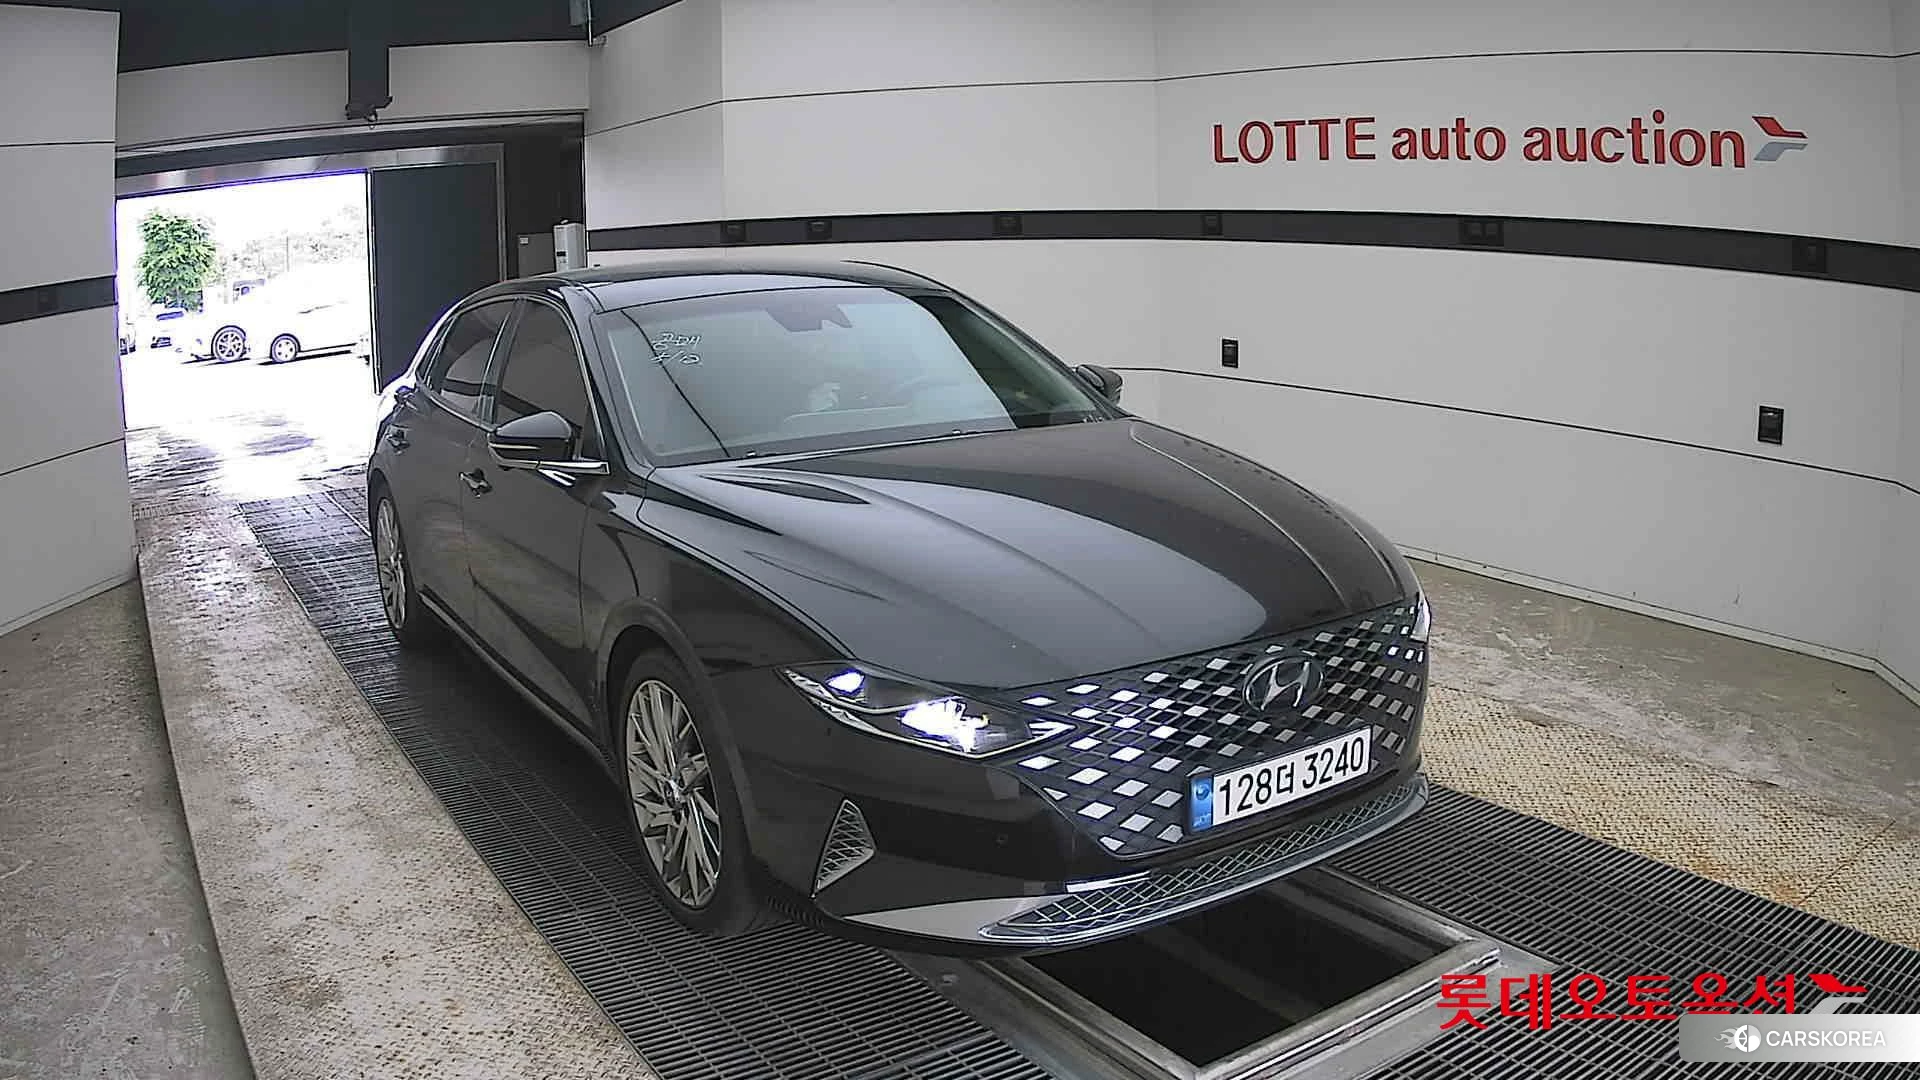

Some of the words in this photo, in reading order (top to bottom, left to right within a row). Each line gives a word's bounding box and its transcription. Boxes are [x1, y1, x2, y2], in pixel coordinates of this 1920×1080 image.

[1213, 116, 1376, 163] LOTTE
[1391, 117, 1507, 162] auto
[1522, 109, 1747, 168] auction
[1218, 761, 1295, 817] 128더
[1301, 736, 1365, 790] 3240
